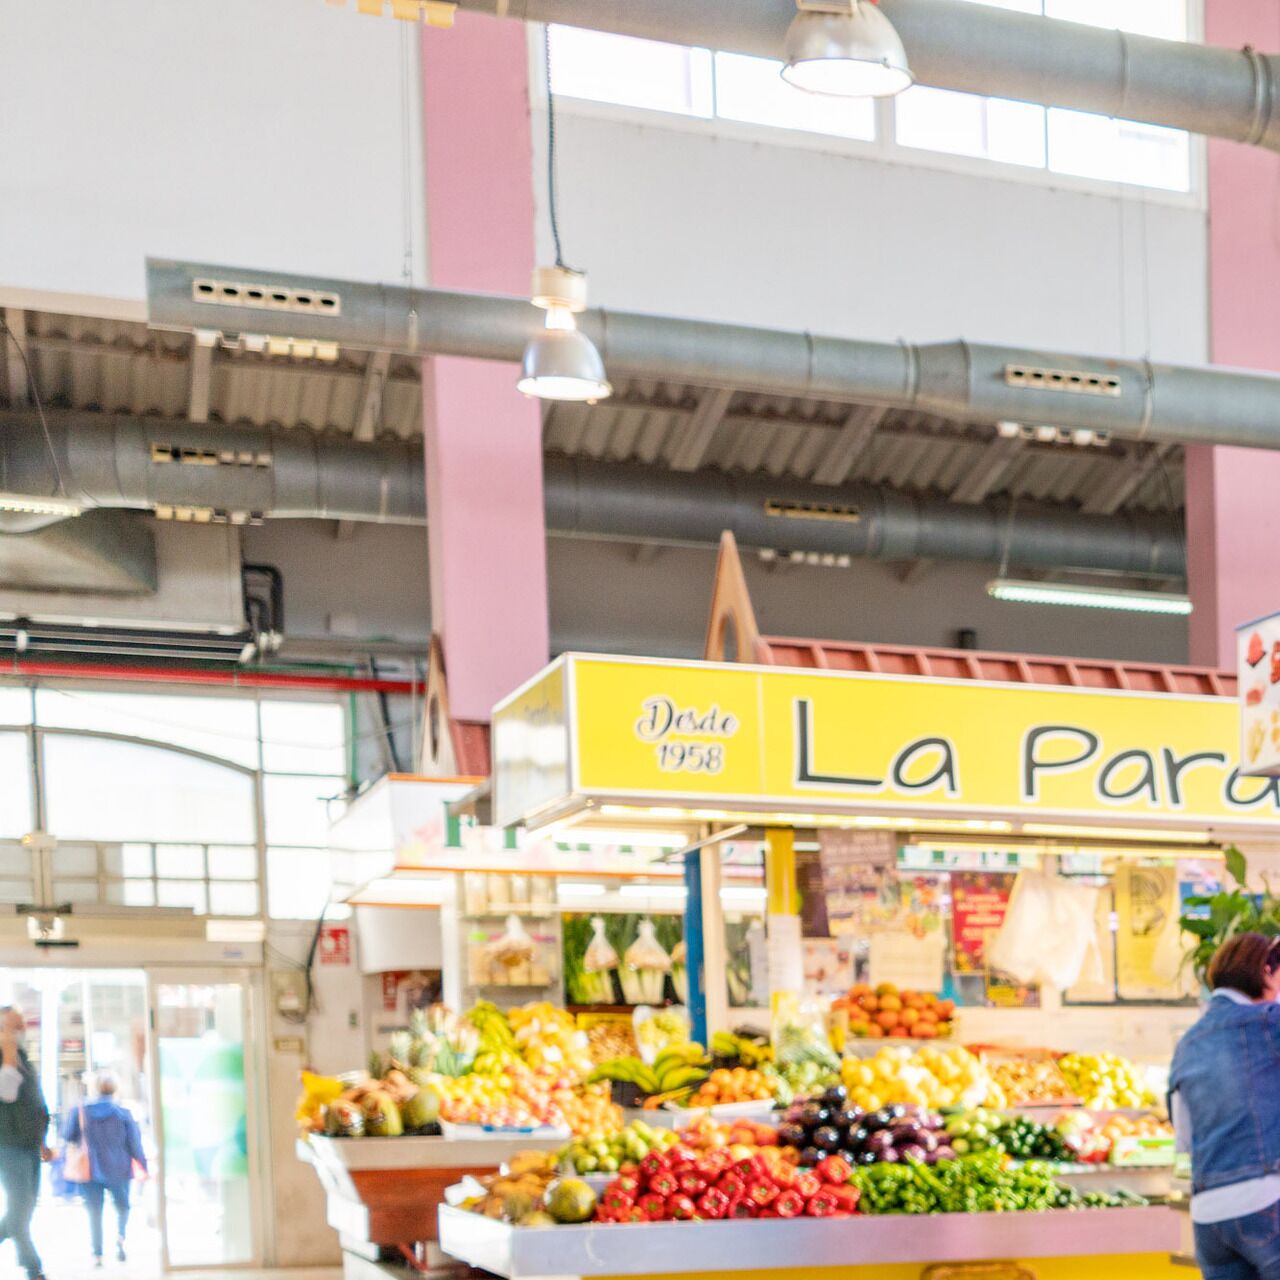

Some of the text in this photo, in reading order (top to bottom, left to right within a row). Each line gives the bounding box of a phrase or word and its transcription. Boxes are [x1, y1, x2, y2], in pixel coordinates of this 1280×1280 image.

[636, 696, 737, 741] Desde
[660, 743, 722, 772] 1958
[798, 699, 956, 792] La
